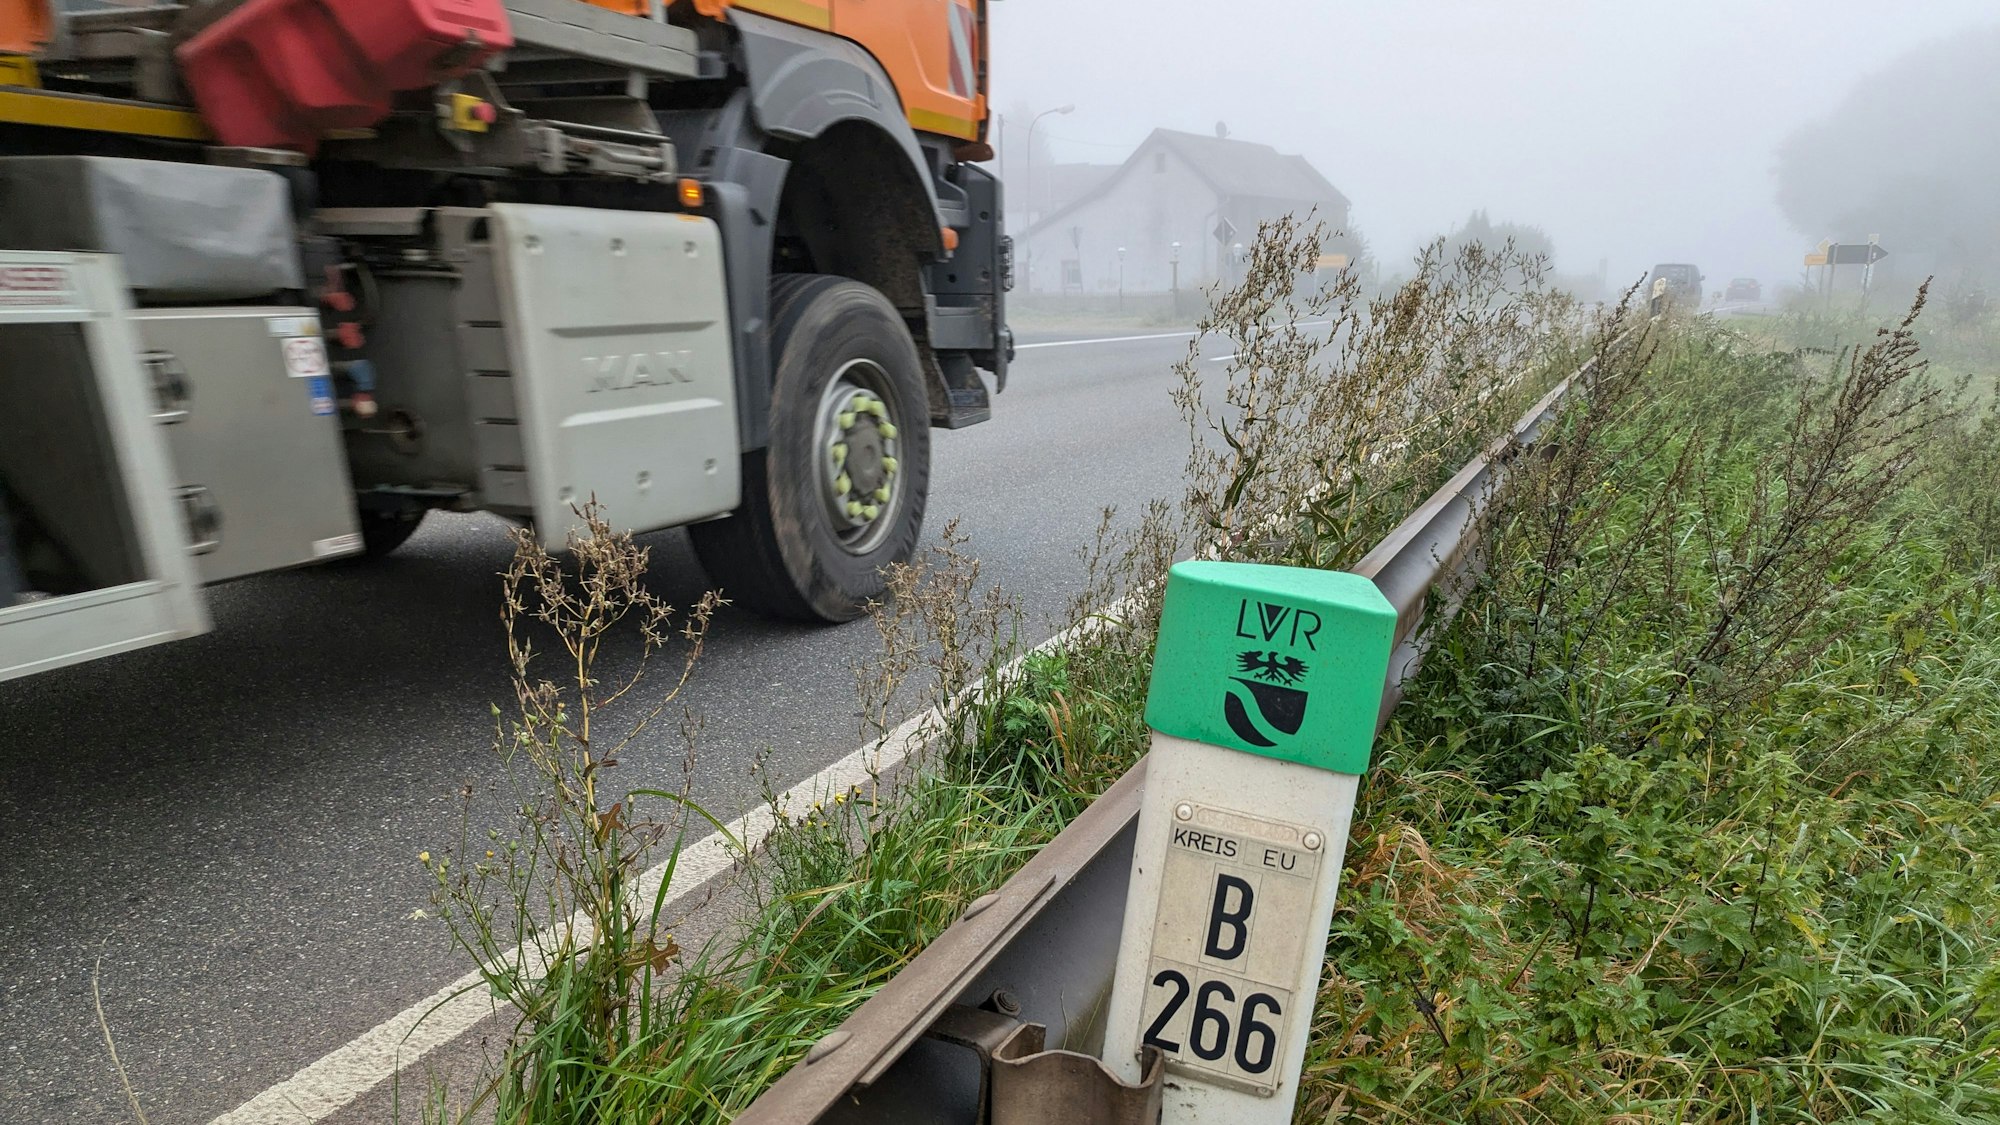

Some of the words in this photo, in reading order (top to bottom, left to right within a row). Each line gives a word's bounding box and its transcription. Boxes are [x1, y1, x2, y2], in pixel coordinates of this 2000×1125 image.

[1235, 598, 1322, 652] LVR
[1173, 827, 1238, 858] KREIS
[1262, 848, 1297, 871] EU
[1204, 872, 1254, 961] B
[1143, 969, 1282, 1074] 266
